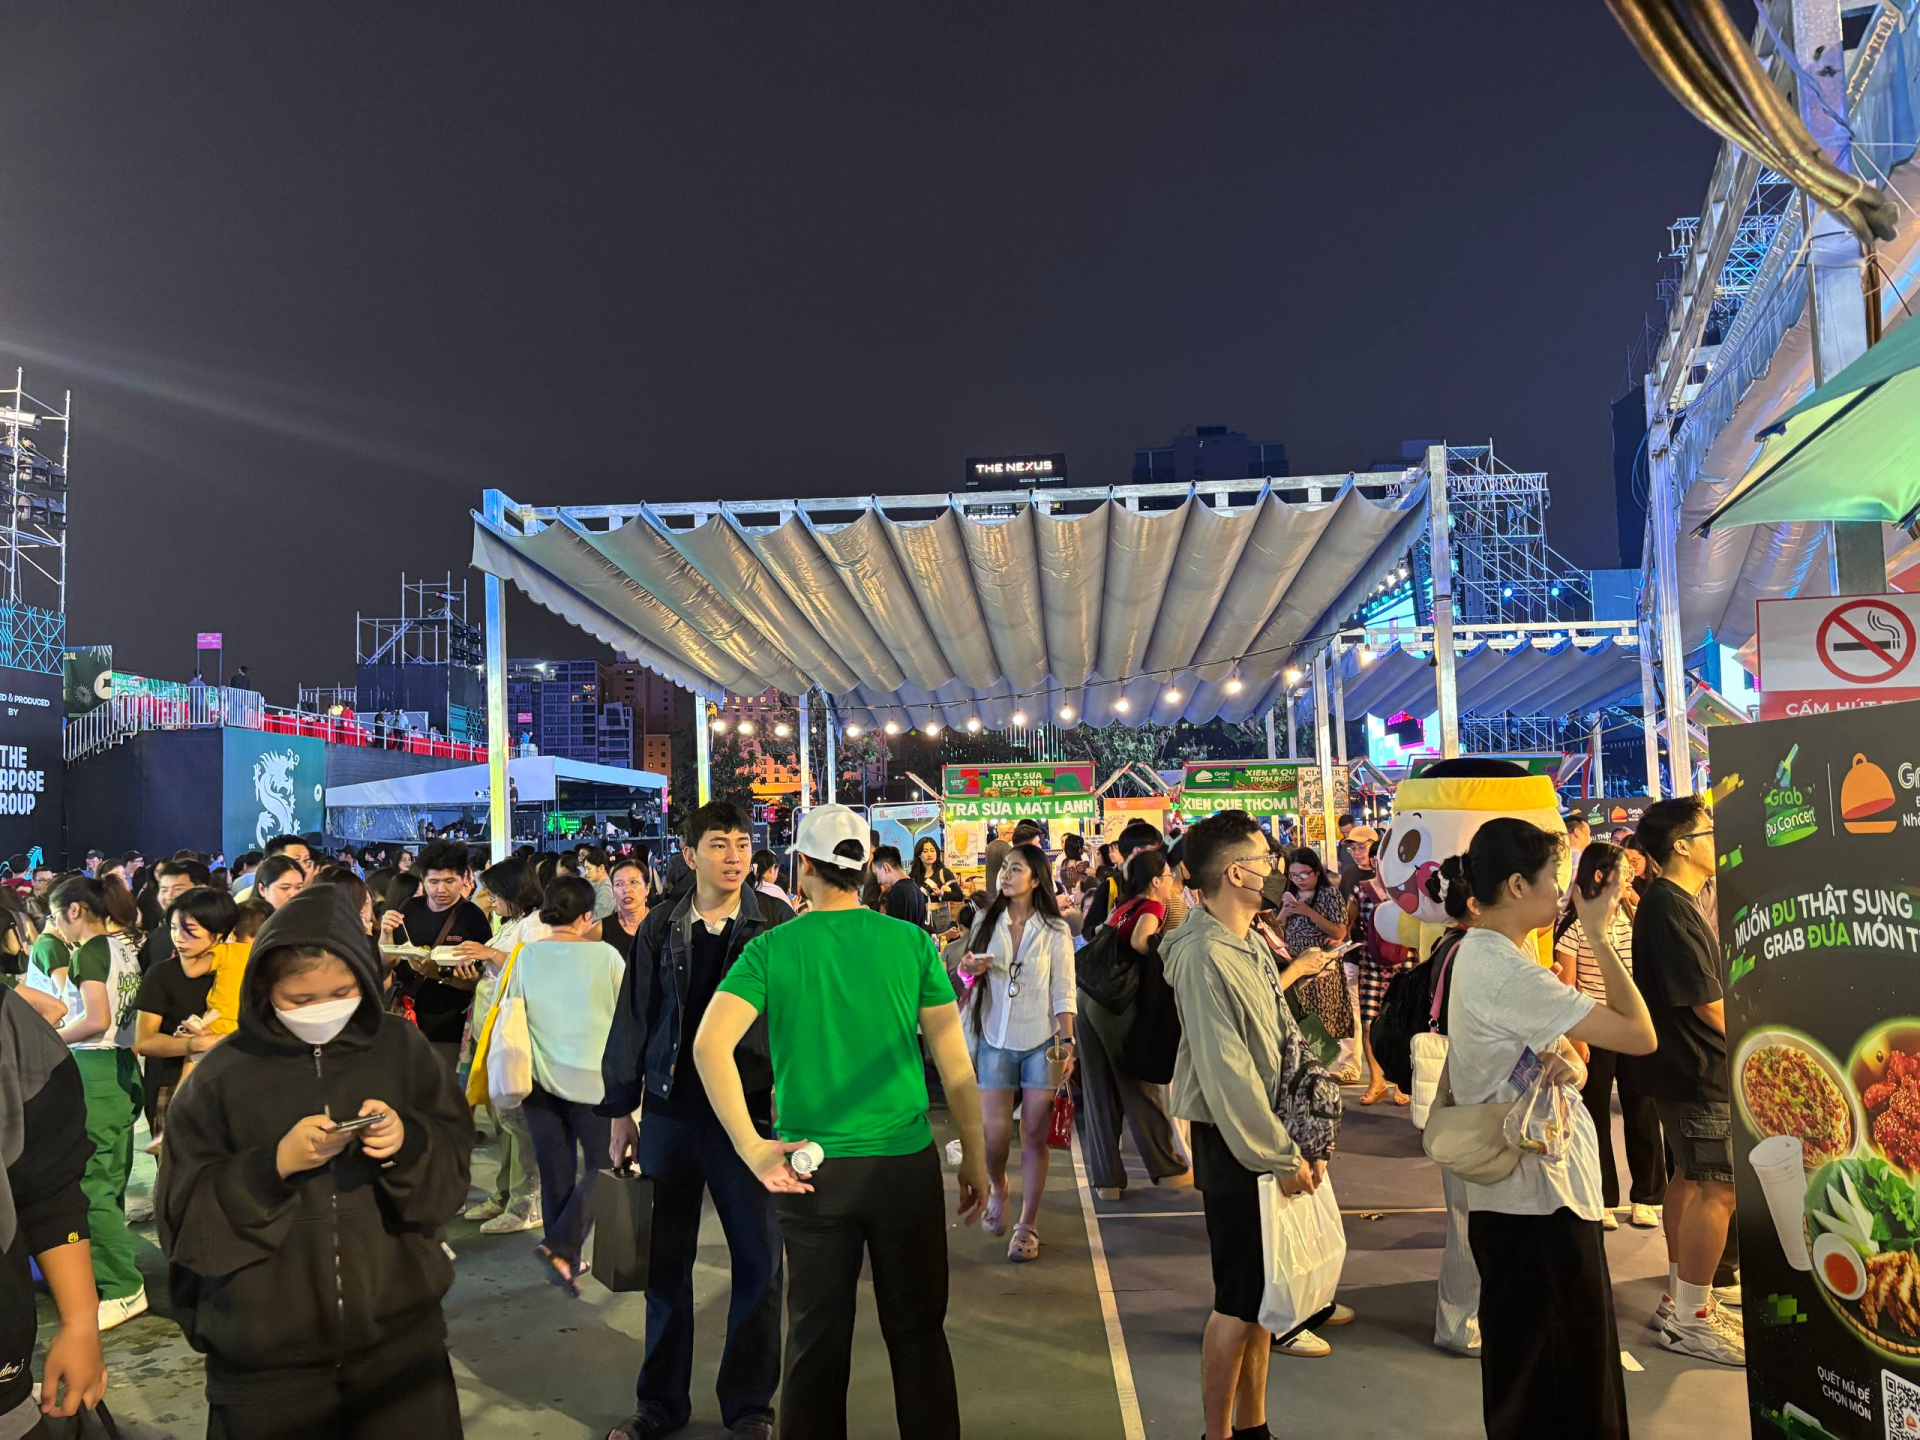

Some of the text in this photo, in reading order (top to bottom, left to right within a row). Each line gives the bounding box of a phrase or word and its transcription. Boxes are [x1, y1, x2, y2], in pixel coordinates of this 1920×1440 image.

[975, 460, 1053, 473] THE NEXUS
[14, 694, 50, 707] PRODUCED
[1785, 698, 1829, 716] CẤM
[8, 708, 19, 717] BY
[0, 745, 28, 769] THE
[1213, 798, 1243, 811] QUE
[1769, 786, 1803, 807] Grab
[1735, 884, 1913, 950] MUỐN ĐU THẬT SUNG
[1763, 928, 1806, 960] GRAB
[1807, 919, 1851, 949] ĐƯA
[1852, 915, 1905, 951] MÓN
[1817, 1366, 1871, 1404] QUÉT MÃ ĐỂ
[1822, 1384, 1872, 1421] CHỌN MÓN
